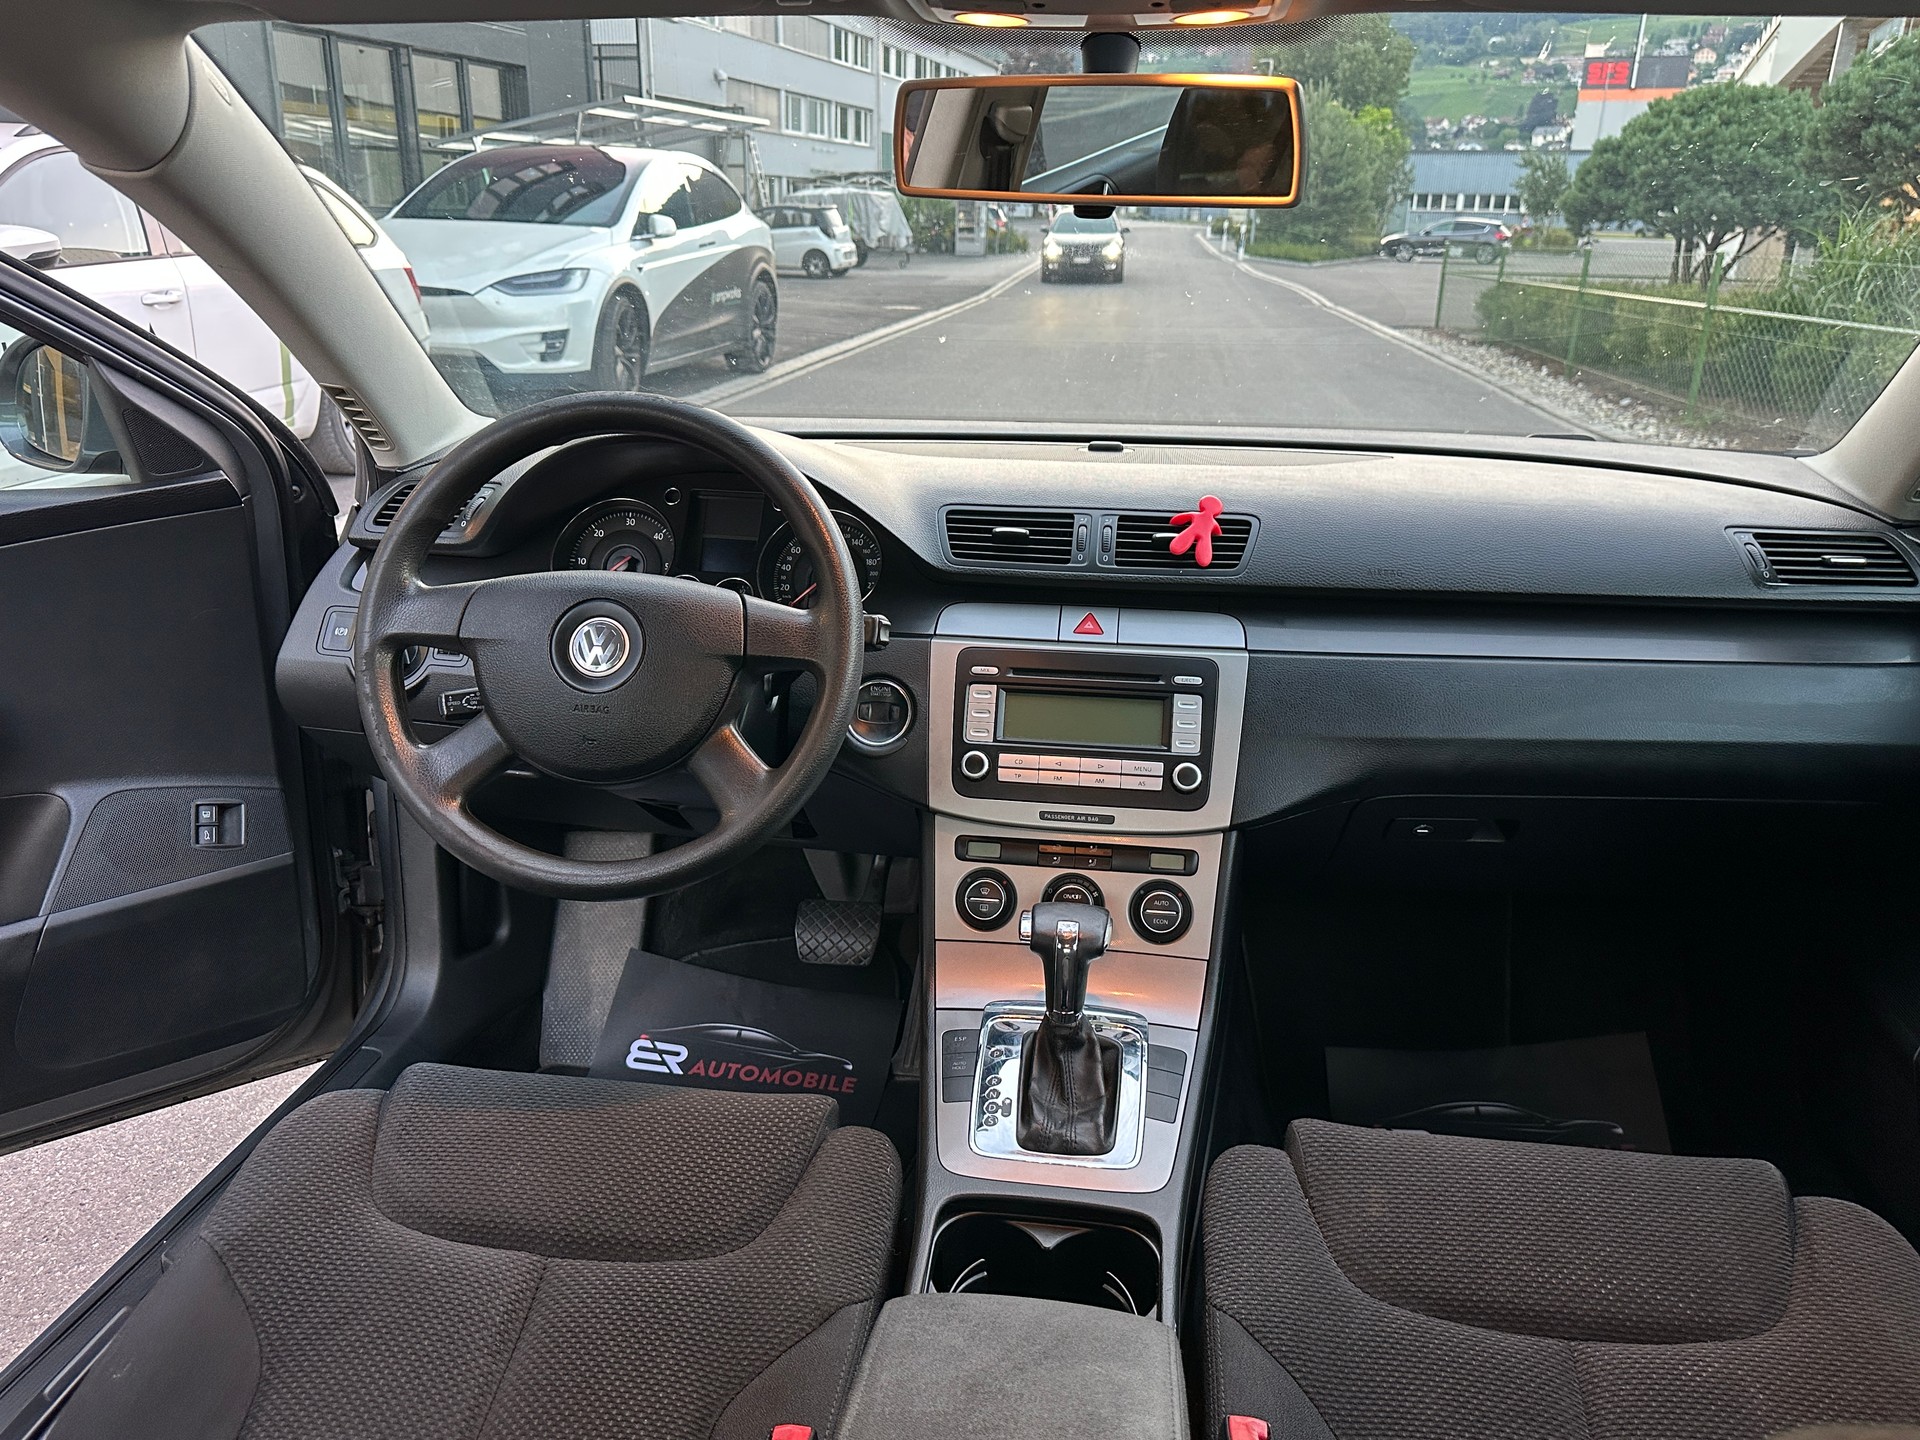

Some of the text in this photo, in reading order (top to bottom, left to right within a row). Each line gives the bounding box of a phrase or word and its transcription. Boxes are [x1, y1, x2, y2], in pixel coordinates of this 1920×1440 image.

[1586, 62, 1630, 85] SFS
[625, 518, 636, 526] 30
[593, 529, 605, 537] 20
[653, 532, 664, 540] 40
[790, 546, 801, 554] 60
[577, 557, 587, 565] 10
[781, 563, 792, 571] 40
[780, 583, 790, 592] 20
[572, 704, 610, 714] AIRBAG
[1044, 813, 1075, 821] PASSENGER
[688, 1058, 857, 1093] AUTOMOBILE
